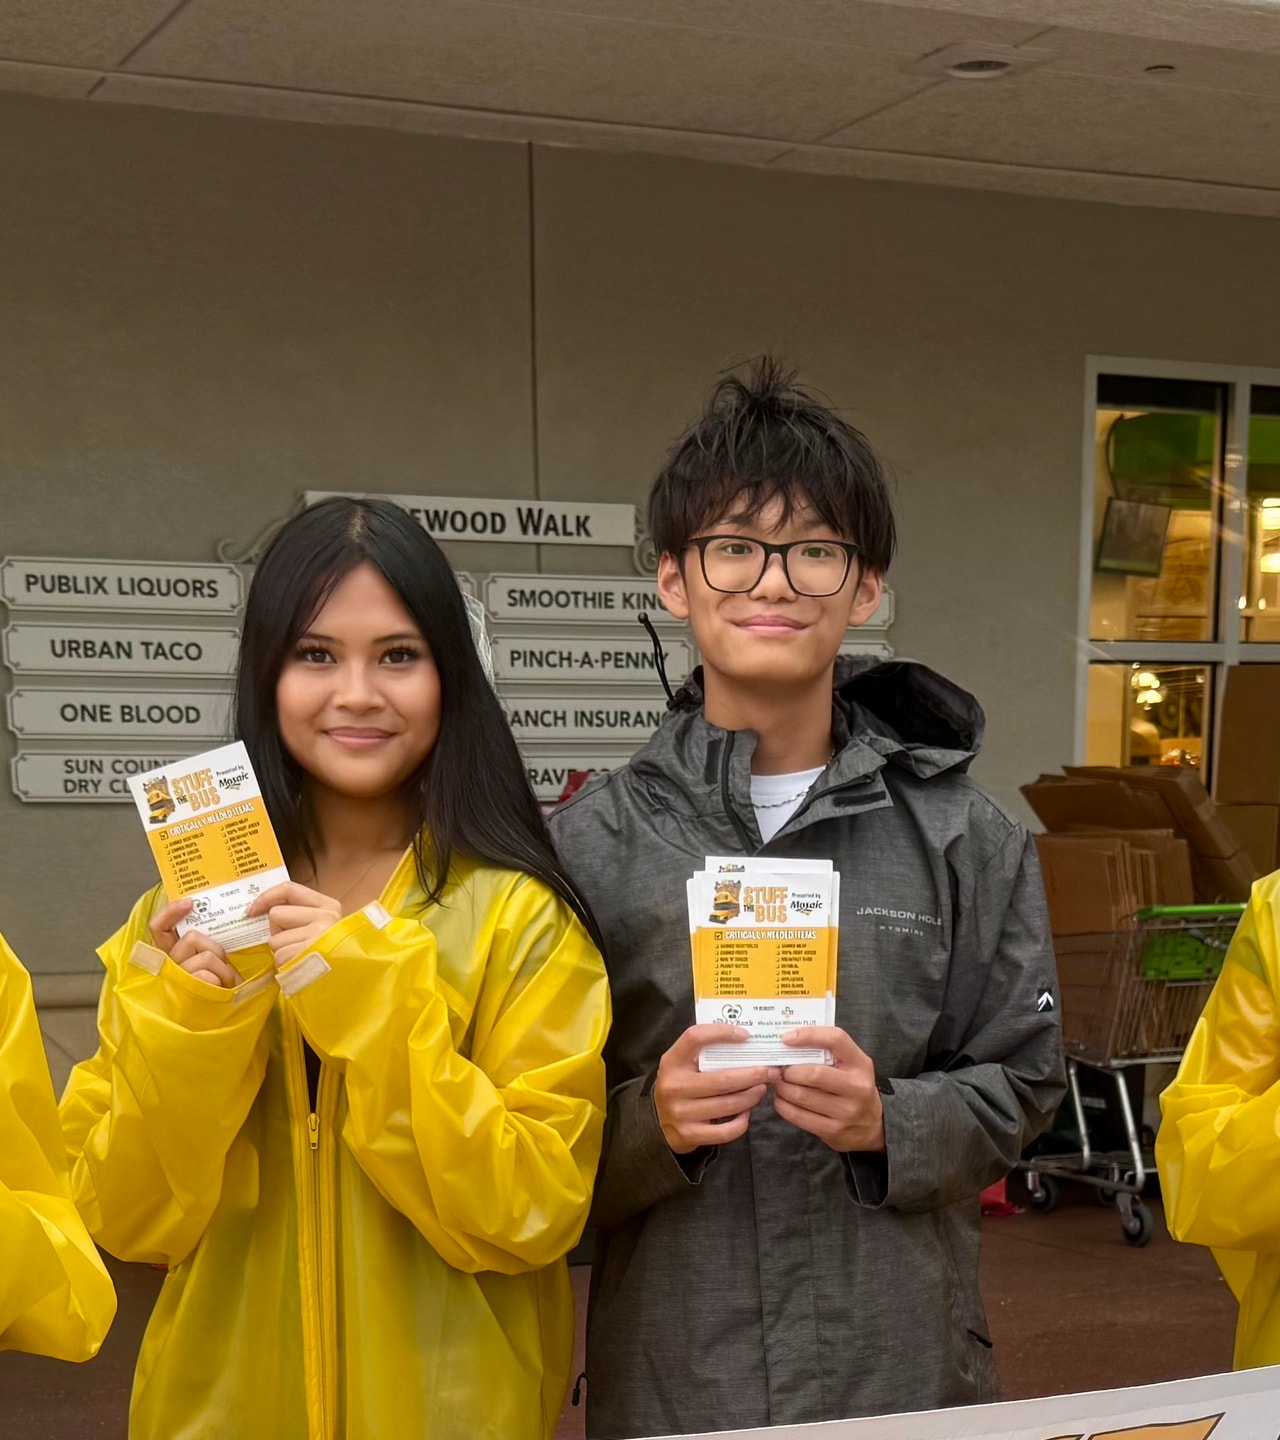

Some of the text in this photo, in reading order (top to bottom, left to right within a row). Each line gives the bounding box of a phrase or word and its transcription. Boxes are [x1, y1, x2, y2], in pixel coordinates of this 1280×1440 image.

[25, 574, 218, 598] PUBLIX LIQUORS
[507, 590, 614, 609] SMOOTHIE
[50, 638, 203, 661] URBAN TACO
[60, 704, 201, 724] ONE BLOOD
[511, 710, 568, 728] ANCH
[64, 759, 177, 774] SUN COUN
[64, 779, 101, 794] DRY
[171, 768, 214, 796] STUFF
[219, 771, 249, 788] Mosaic
[188, 788, 220, 812] BUS
[743, 886, 789, 905] STUFF
[790, 900, 823, 909] Mosaic
[755, 904, 788, 923] BUS
[856, 907, 916, 920] JACKSON
